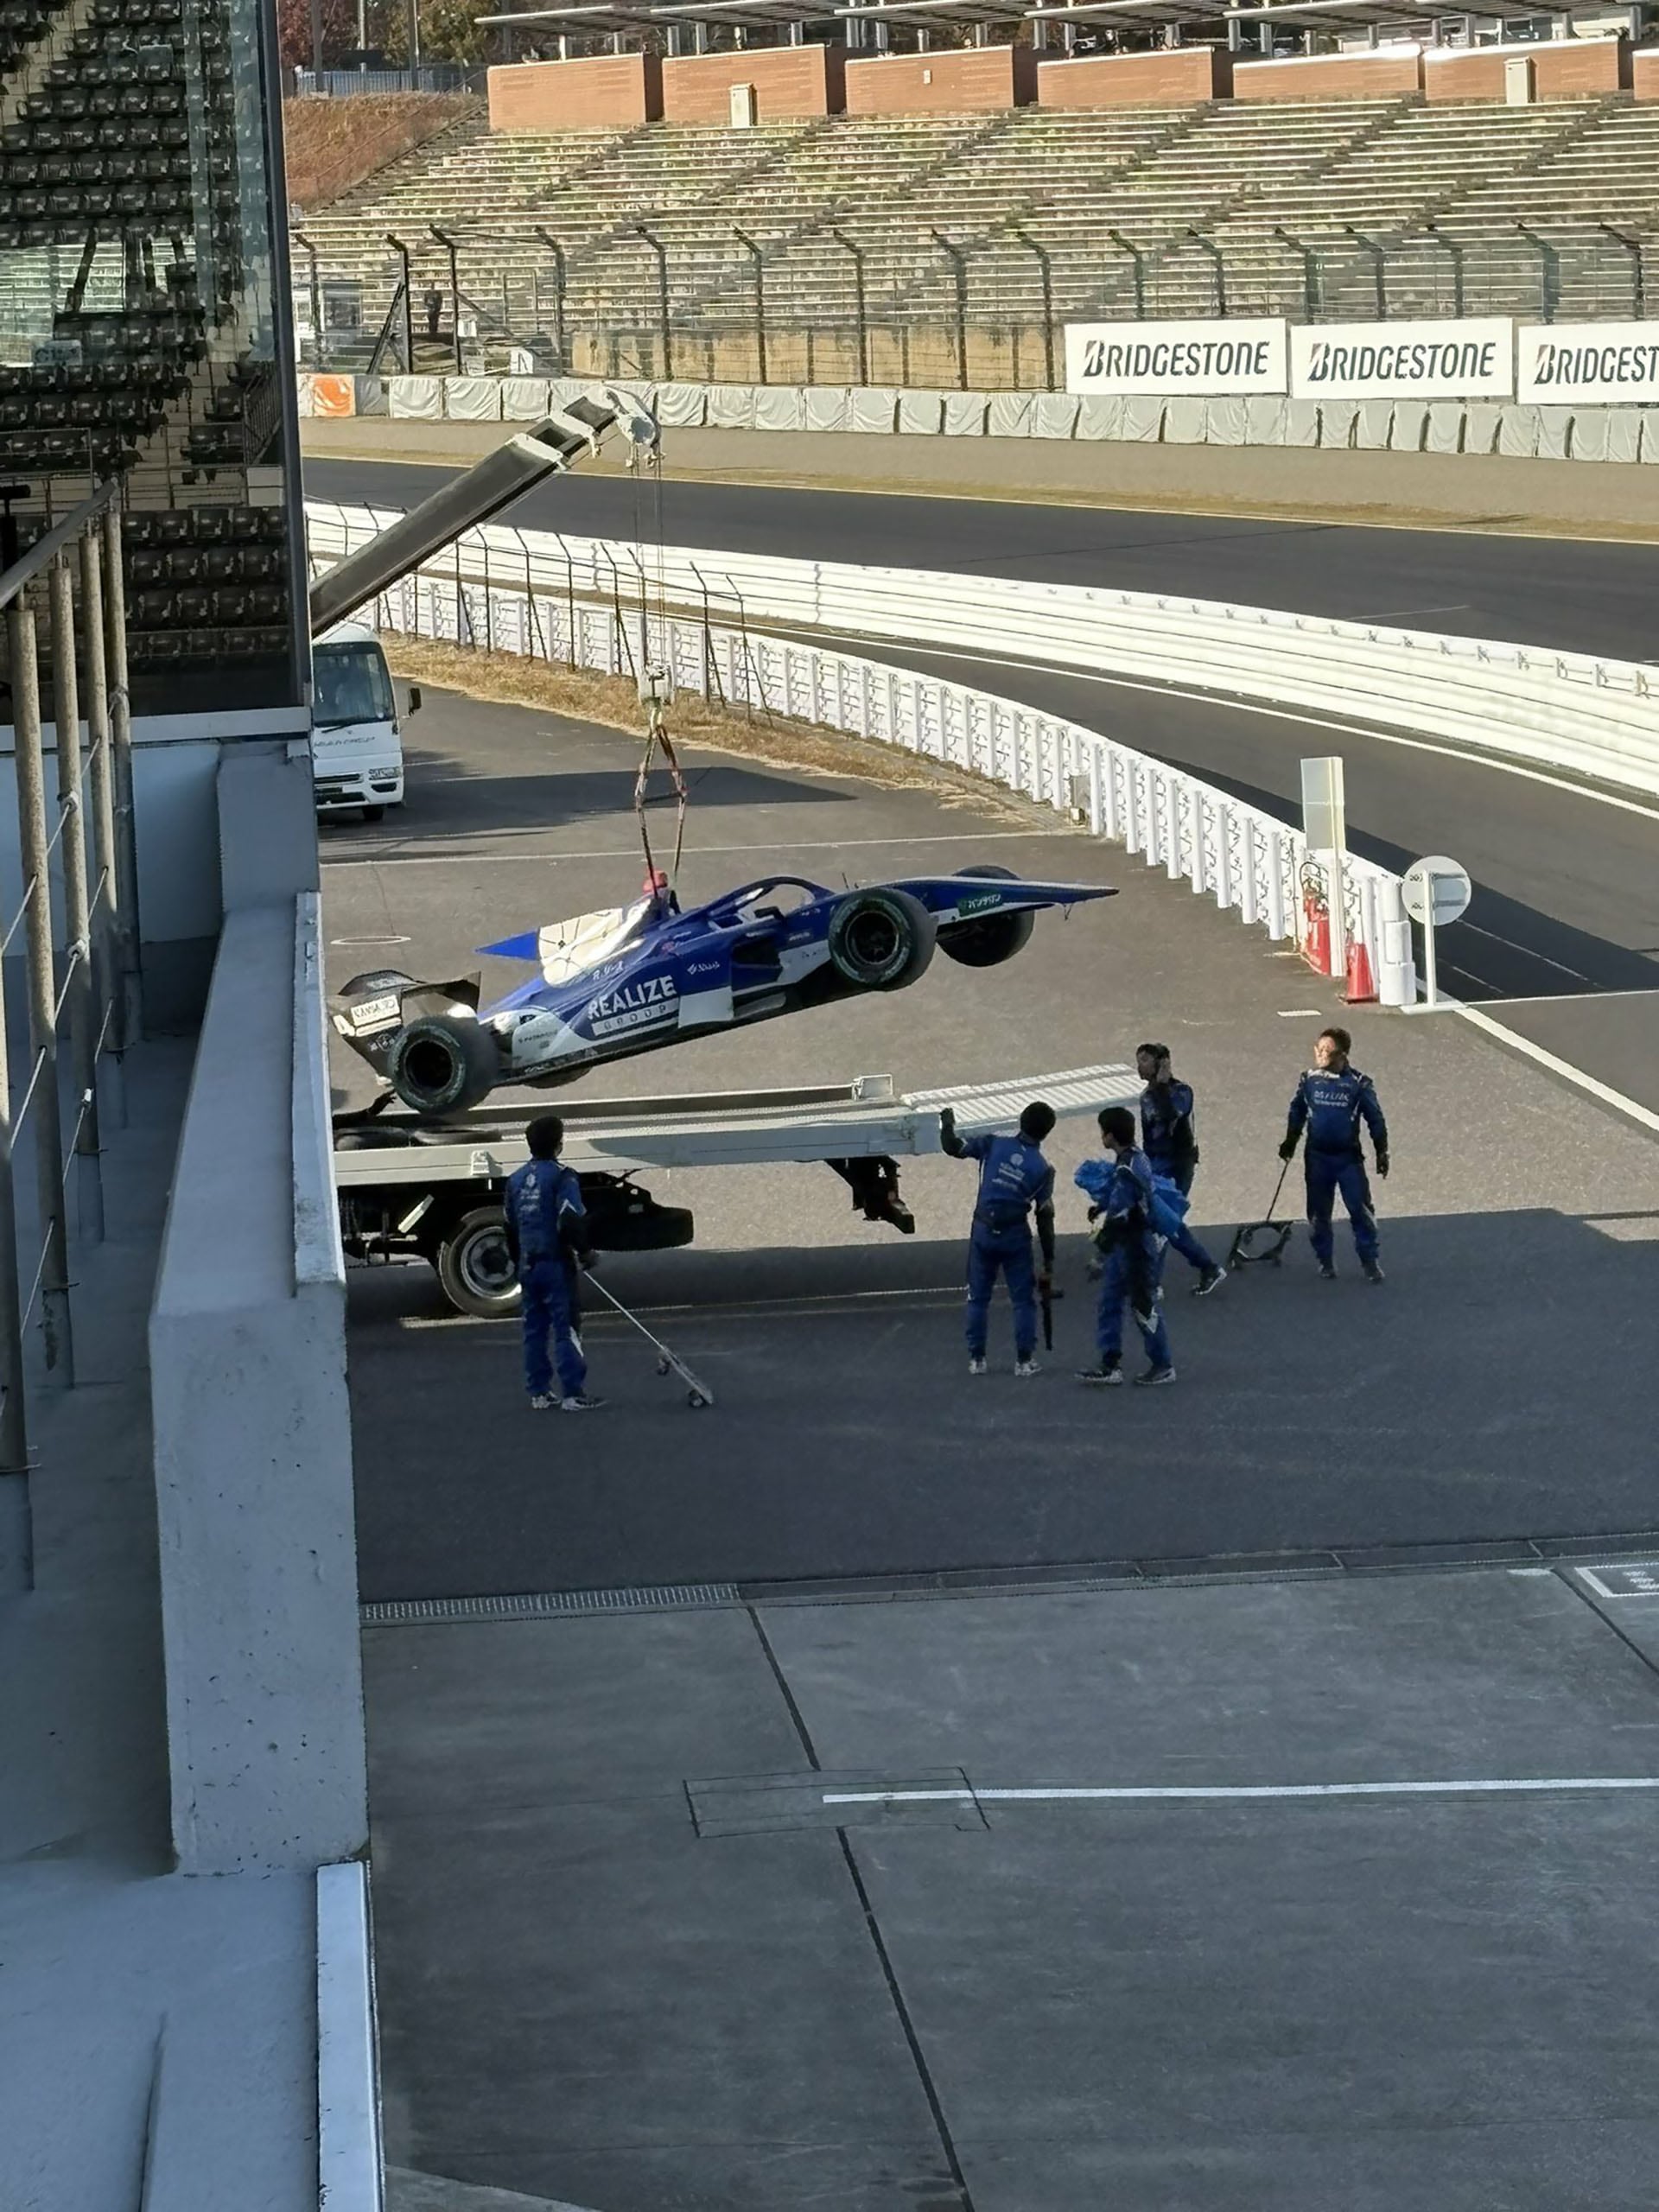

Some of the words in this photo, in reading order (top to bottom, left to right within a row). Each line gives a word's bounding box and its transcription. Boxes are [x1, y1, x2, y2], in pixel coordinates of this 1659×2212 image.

[1083, 340, 1270, 378] BRIDGESTONE
[1307, 342, 1497, 382] BRIDGESTONE
[588, 975, 677, 1020] REALIZE
